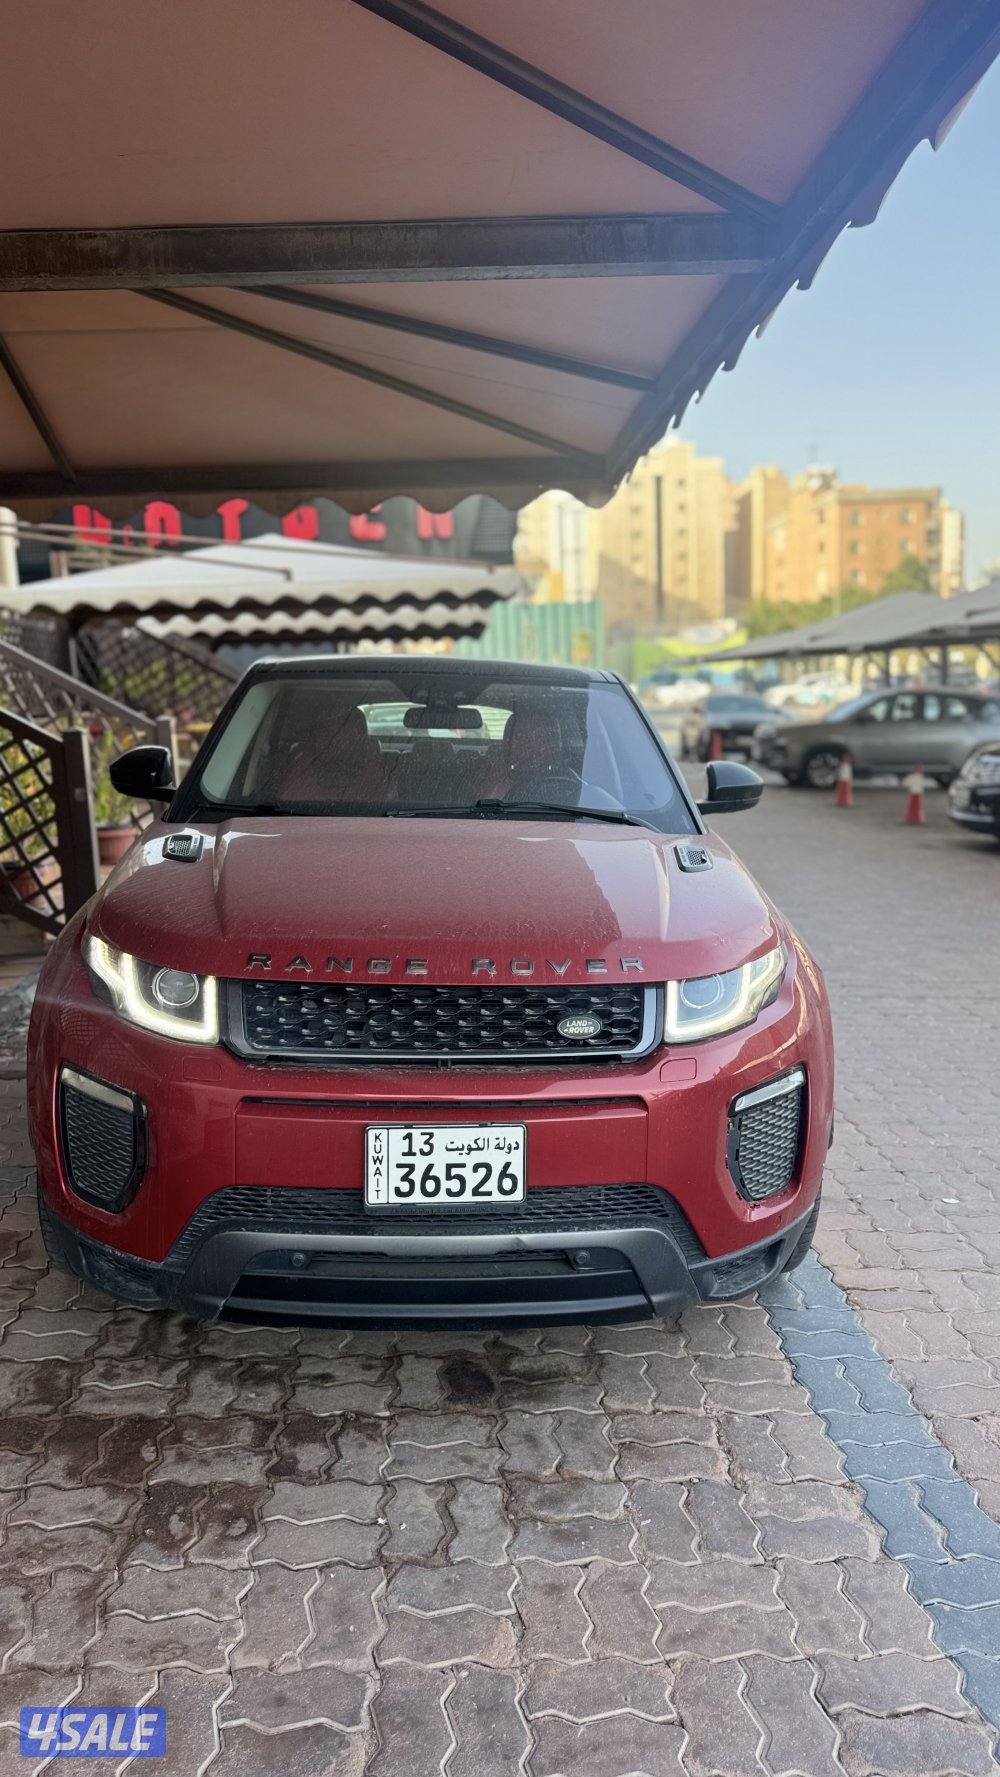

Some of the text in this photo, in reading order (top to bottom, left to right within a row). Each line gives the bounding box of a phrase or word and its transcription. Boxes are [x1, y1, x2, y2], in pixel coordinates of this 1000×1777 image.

[246, 953, 645, 976] RANGE ROVER
[401, 1132, 435, 1157] 13
[445, 1136, 520, 1156] دولة الكويت
[372, 1132, 384, 1200] KUWAIT
[394, 1161, 519, 1198] 36526
